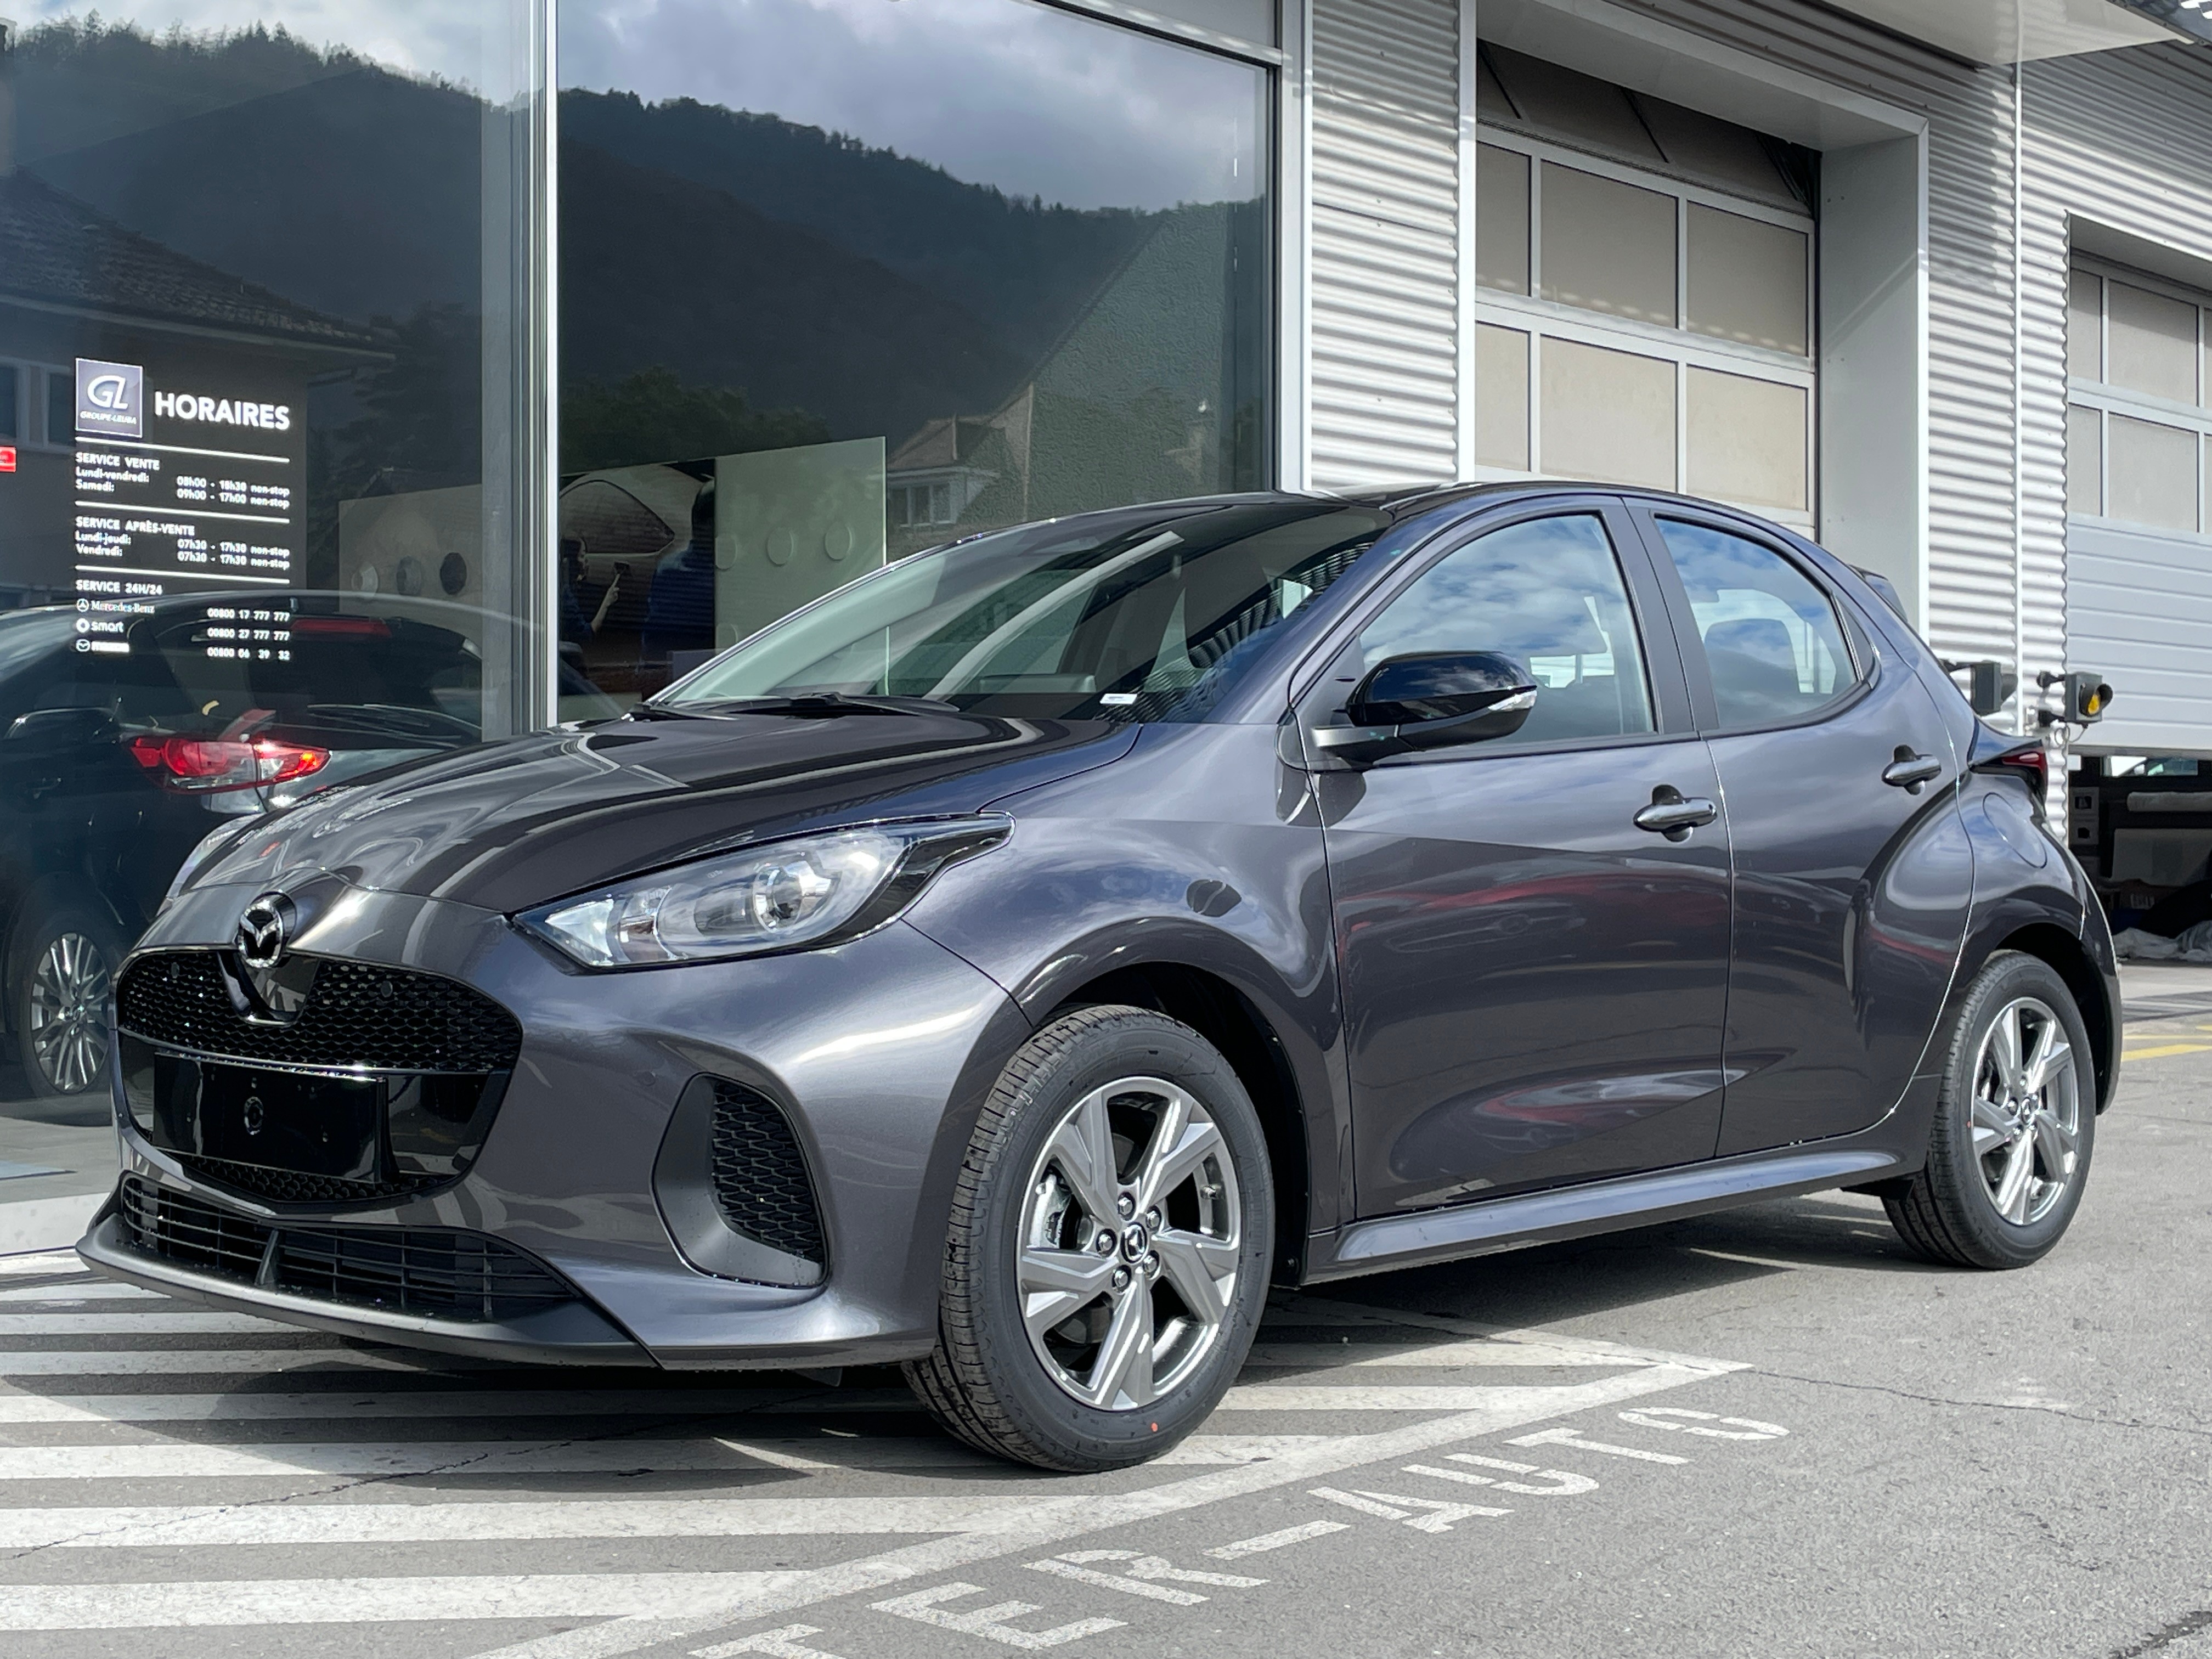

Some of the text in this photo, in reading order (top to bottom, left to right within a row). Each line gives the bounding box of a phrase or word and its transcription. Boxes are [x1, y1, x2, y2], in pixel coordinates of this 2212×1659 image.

[88, 375, 128, 410] GL
[155, 391, 290, 430] HORAIRES
[75, 452, 161, 470] SERVICE VENTE
[75, 478, 115, 492] Samedi:
[250, 484, 290, 498] non-stop
[219, 492, 246, 504] 17h00
[250, 497, 290, 510] non-stop
[75, 516, 195, 536] SERVICE APRÈS-VENTE
[75, 543, 122, 557] Vendredi:
[177, 539, 207, 550] 07h30
[220, 541, 246, 553] 17h30
[250, 546, 290, 558] non-stop
[177, 551, 207, 562] 07h30
[220, 554, 246, 566] 17h30
[250, 558, 290, 571] non-stop
[76, 579, 163, 595] SERVICE 24H/24
[91, 600, 155, 614] Mercedes-Benz
[239, 610, 250, 619] 17
[253, 611, 270, 620] 777
[273, 611, 290, 622] 777
[91, 621, 124, 633] smart
[238, 629, 250, 639] 27
[253, 630, 270, 640] 777
[273, 631, 290, 641] 777
